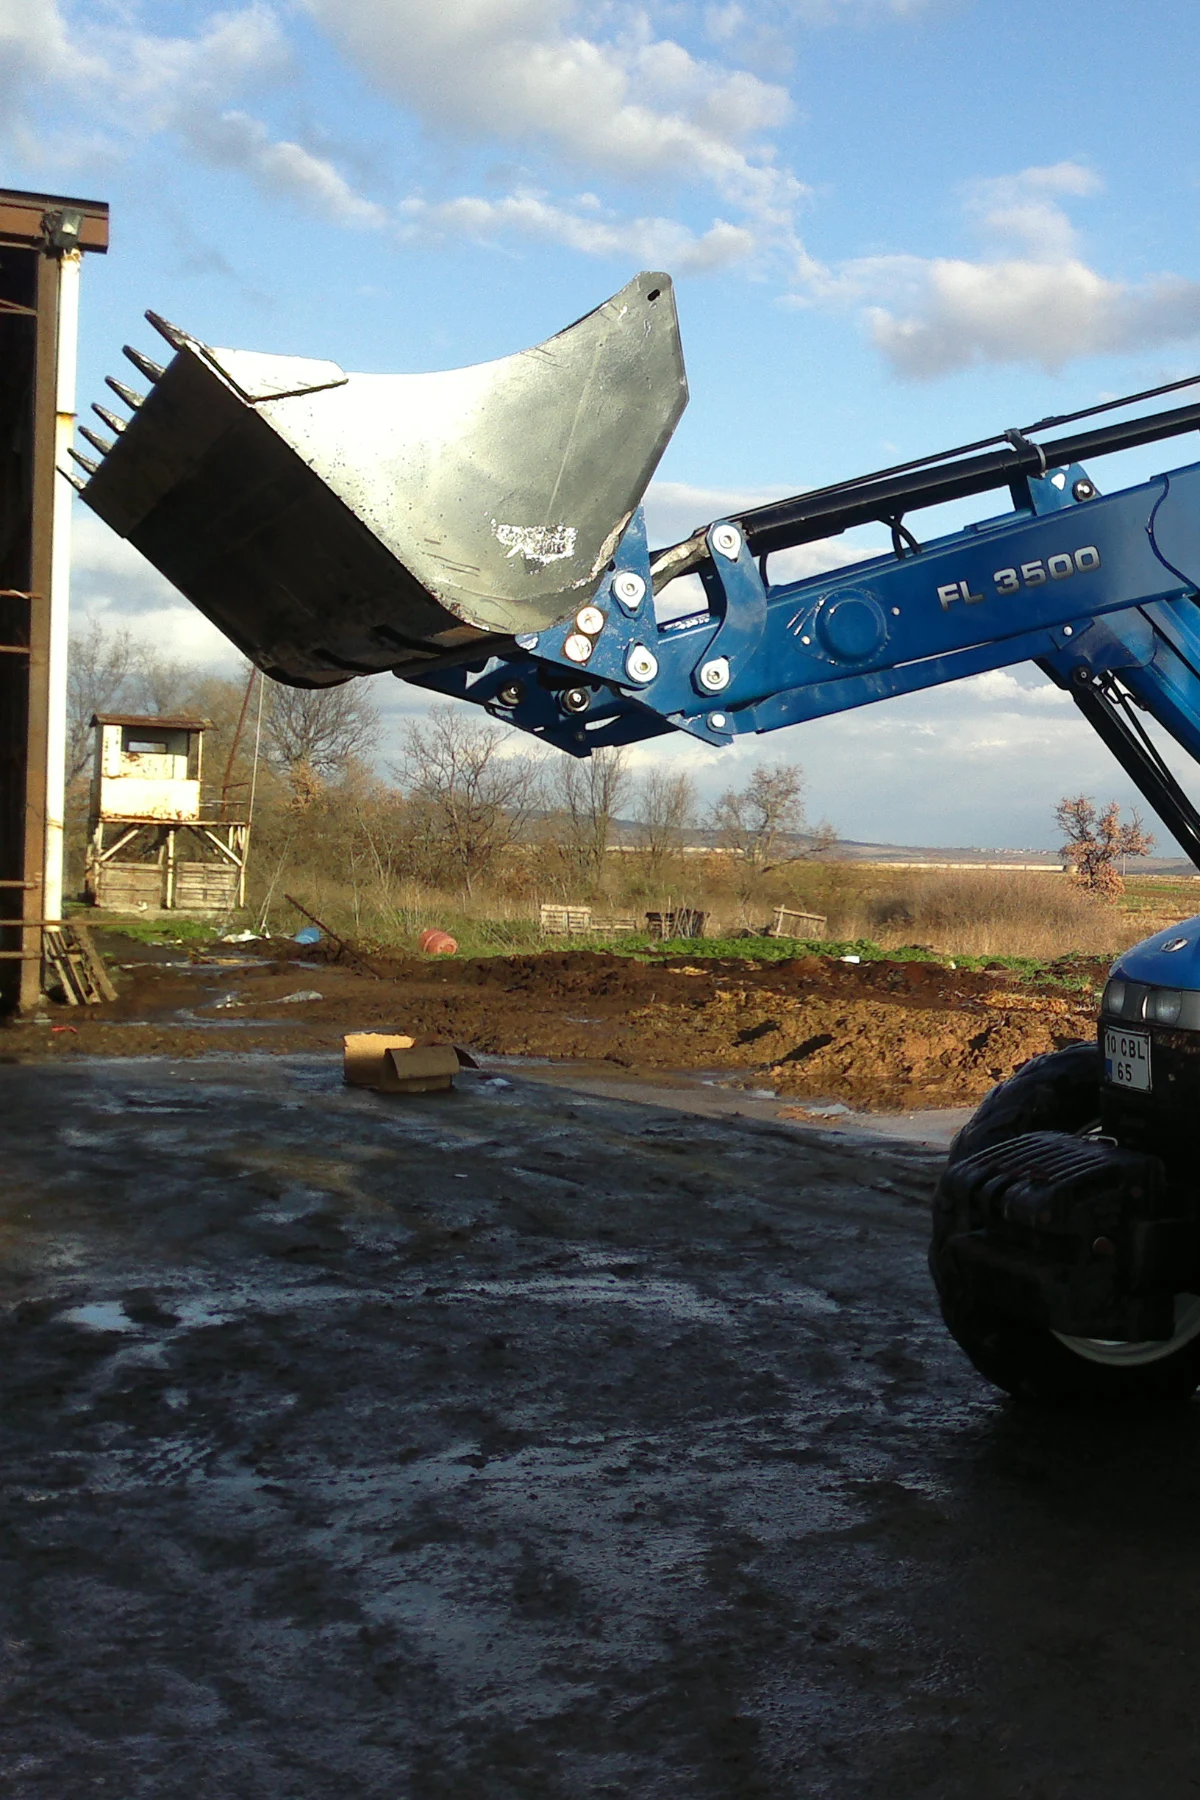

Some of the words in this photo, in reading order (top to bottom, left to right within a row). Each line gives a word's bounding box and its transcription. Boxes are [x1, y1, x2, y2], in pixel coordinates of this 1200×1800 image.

[937, 580, 984, 612] FL
[994, 545, 1101, 595] 3500
[1106, 1034, 1117, 1054] 10
[1120, 1038, 1145, 1060] CBL
[1117, 1062, 1132, 1082] 65
